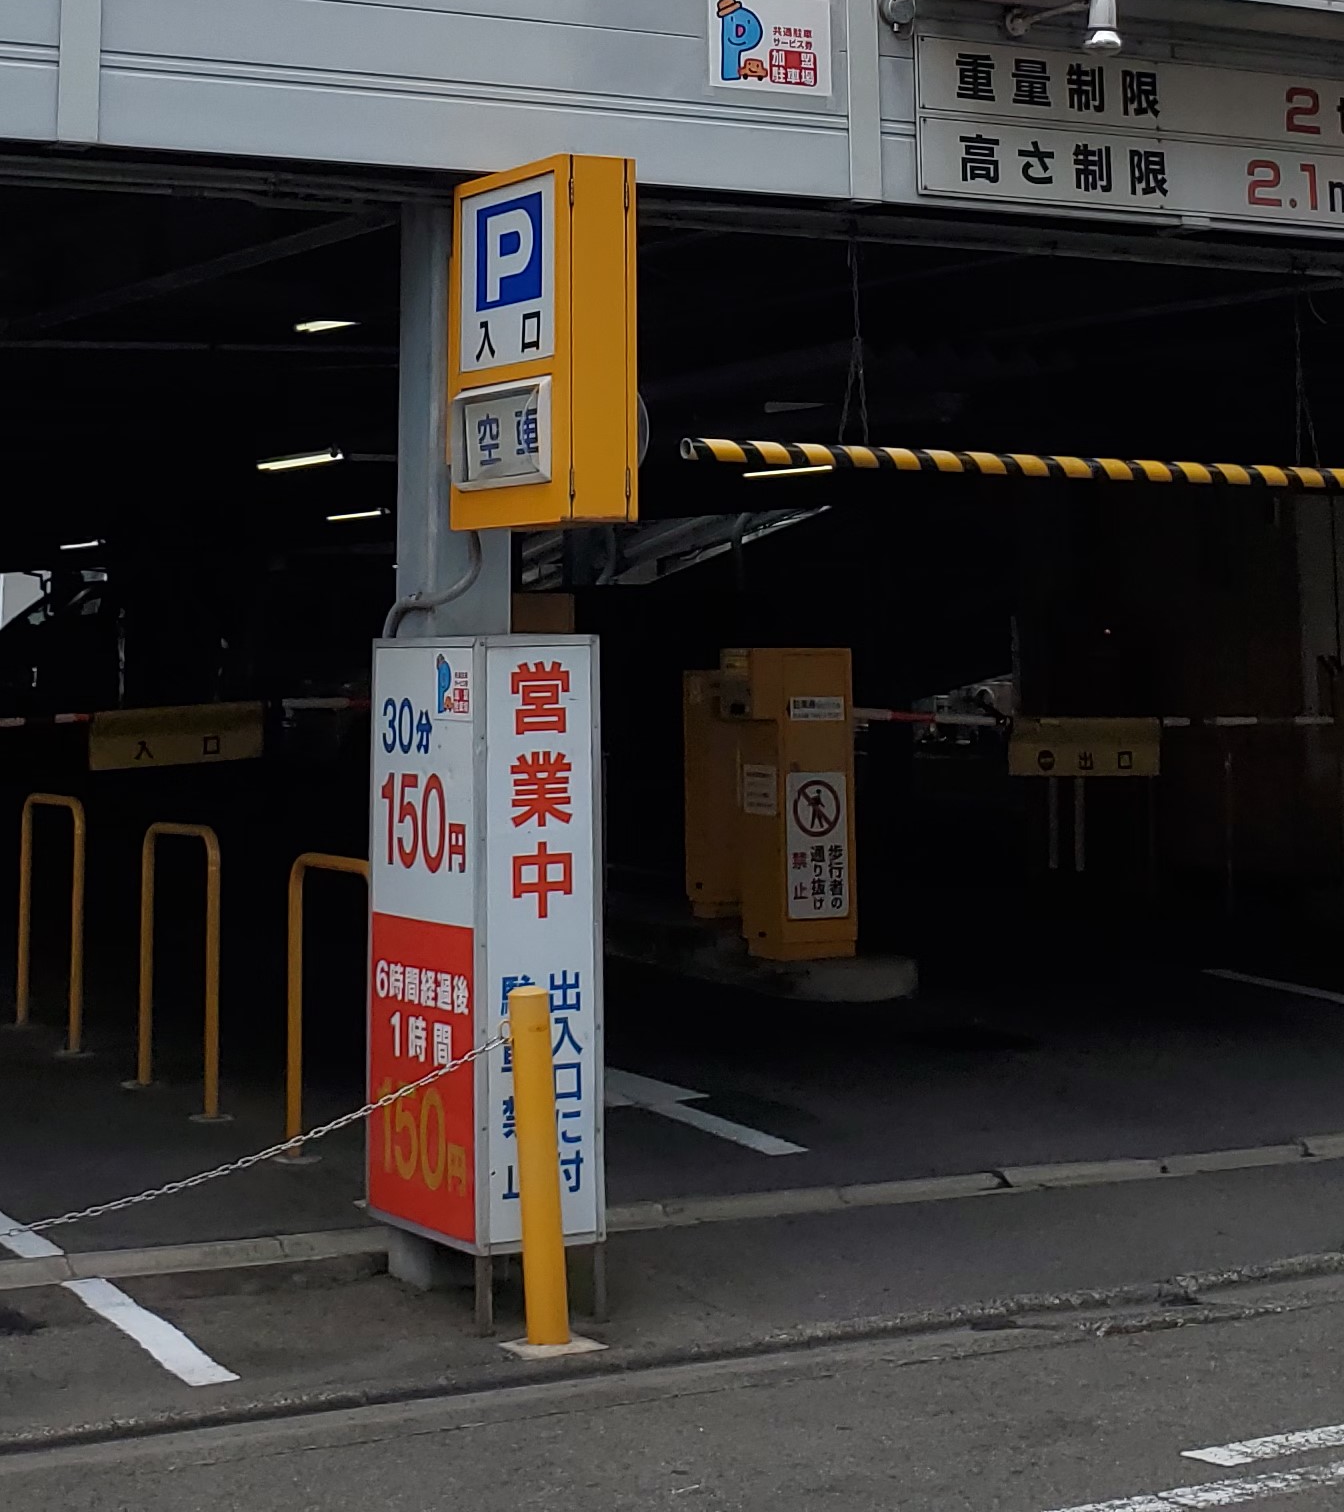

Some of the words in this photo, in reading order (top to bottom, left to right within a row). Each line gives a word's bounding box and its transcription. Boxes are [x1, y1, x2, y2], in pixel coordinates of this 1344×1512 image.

[955, 52, 1161, 120] 重量制限
[959, 133, 1169, 198] 高さ制限
[486, 209, 533, 303] P
[475, 311, 541, 362] 入口
[134, 736, 221, 761] 入口
[382, 697, 433, 754] 30分
[511, 661, 573, 918] 営業中
[1078, 750, 1133, 772] 出口
[381, 771, 467, 874] 150円
[792, 851, 809, 901] 禁止
[810, 844, 826, 910] 通り抜け
[828, 844, 844, 910] 歩行者の
[376, 959, 469, 1016] 6時間経過後
[389, 1011, 453, 1067] 1時間
